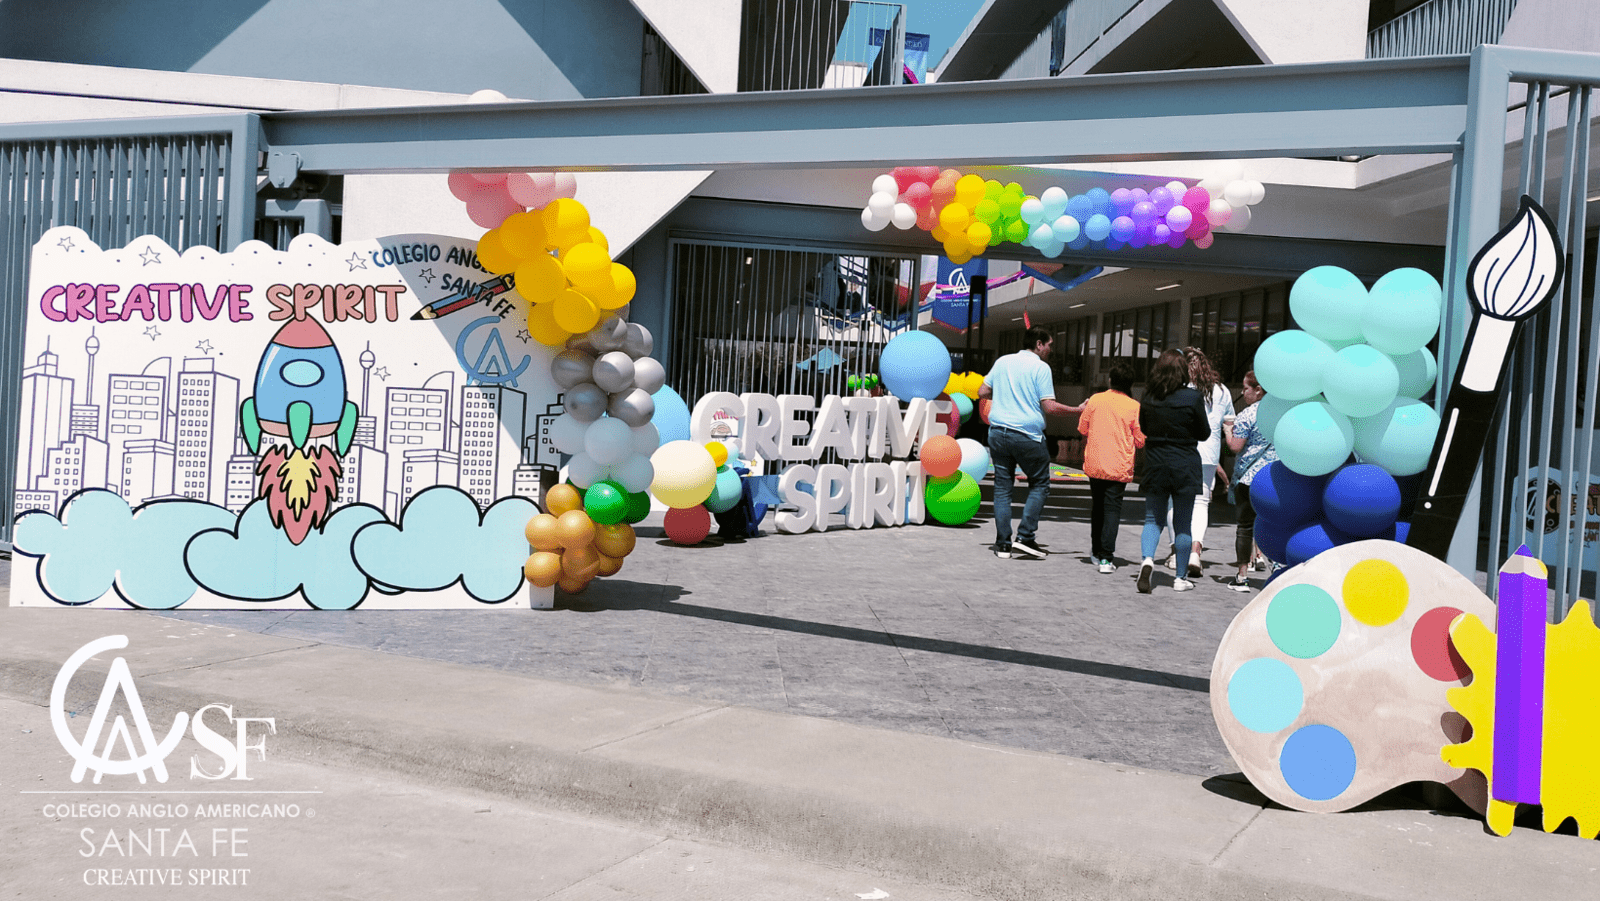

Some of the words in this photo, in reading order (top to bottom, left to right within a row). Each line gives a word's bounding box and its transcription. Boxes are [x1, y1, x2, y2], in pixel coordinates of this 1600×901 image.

[373, 244, 441, 268] COLEGIO
[446, 246, 496, 275] ANG
[40, 283, 254, 323] CREATIVE
[266, 284, 407, 323] SPIRIT
[441, 273, 494, 306] SANTA
[493, 298, 516, 319] FE
[690, 392, 952, 460] CREATIVE
[774, 461, 930, 534] SPIRIT
